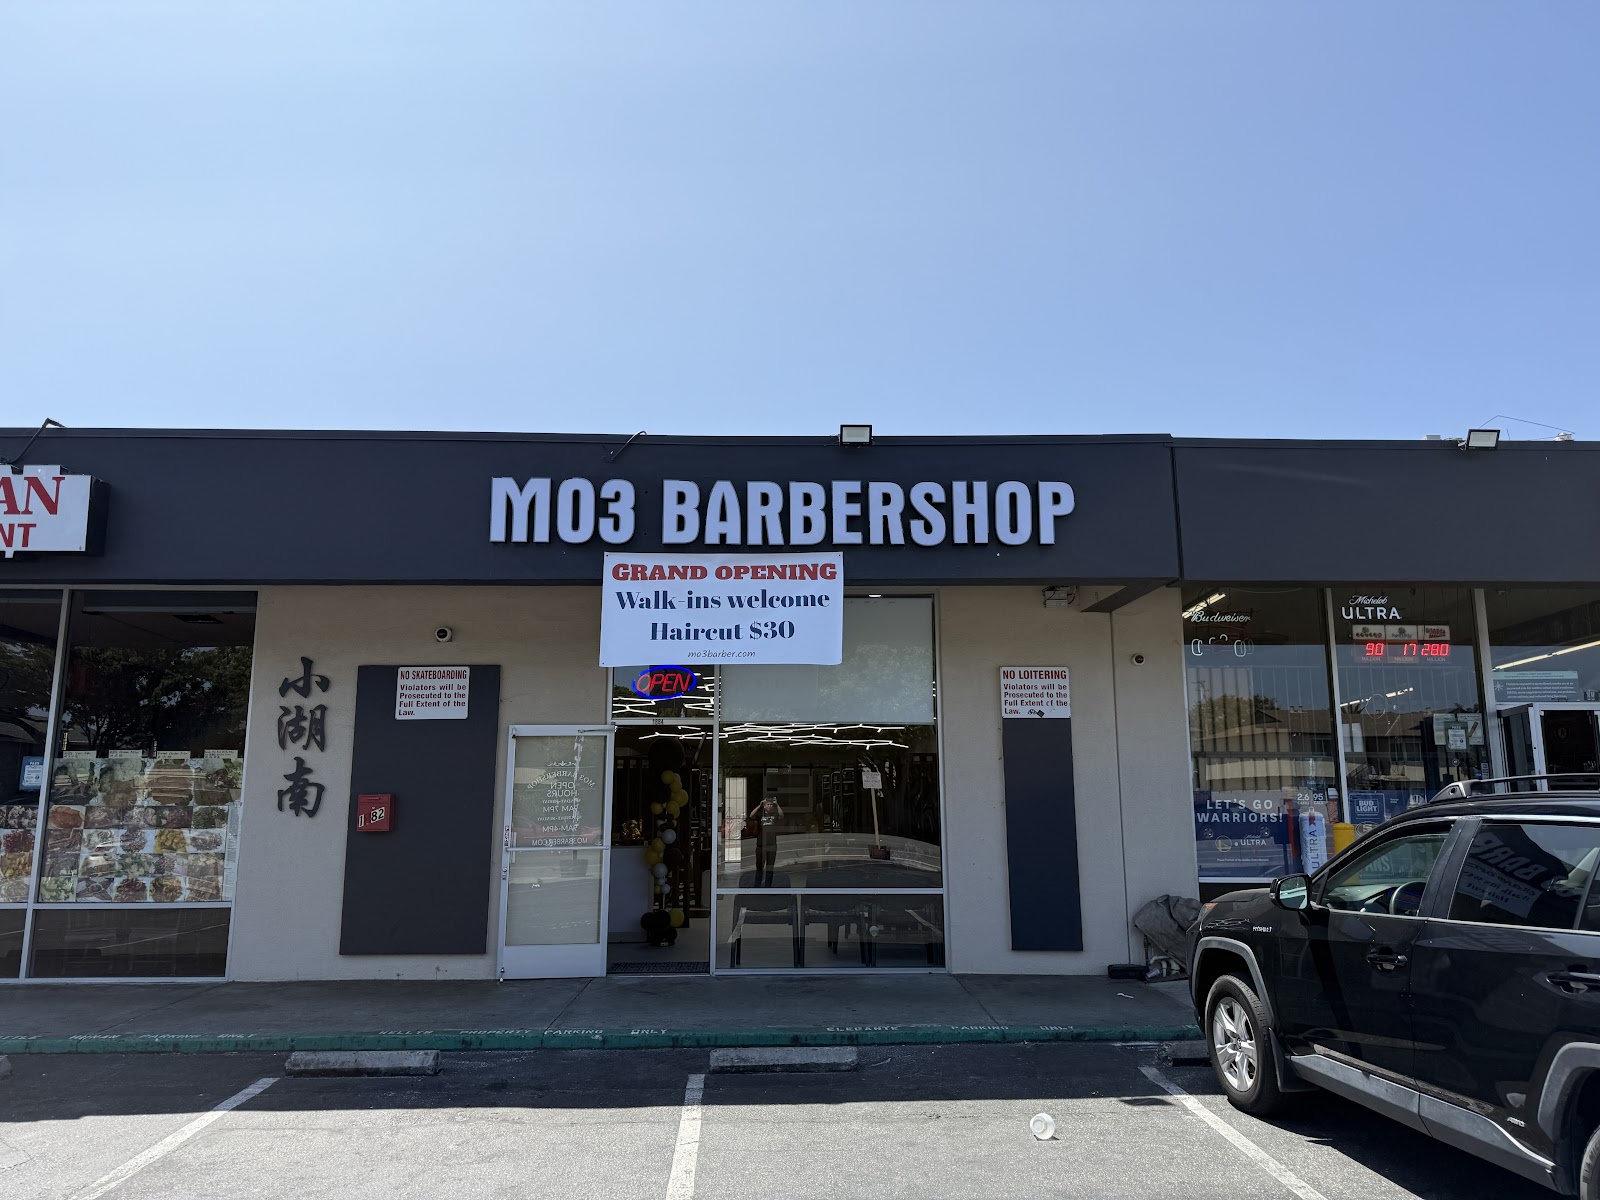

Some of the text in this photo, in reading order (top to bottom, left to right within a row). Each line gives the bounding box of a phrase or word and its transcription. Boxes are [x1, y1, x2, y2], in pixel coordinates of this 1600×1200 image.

[0, 476, 65, 515] AN
[489, 476, 1075, 546] MO3 BARBERSHOP
[612, 563, 837, 581] GRAND OPENING
[615, 589, 830, 609] Walk-ins welcome
[1191, 610, 1251, 622] Budweiser
[1341, 606, 1401, 620] ULTRA
[650, 620, 795, 640] Haircut $30
[687, 649, 756, 659] mo3barber.com
[1366, 643, 1385, 656] 90
[1403, 643, 1417, 656] 17
[1421, 643, 1450, 656] 280
[400, 670, 467, 680] NO SKATEBOARDING
[1002, 670, 1067, 680] NO LOITERING
[636, 673, 692, 693] OPEN
[277, 656, 330, 818] 小湖南
[1206, 798, 1273, 810] LET'S GO
[371, 808, 384, 822] 82
[1197, 812, 1283, 823] WARRIORS!
[1309, 829, 1320, 869] ULTRA
